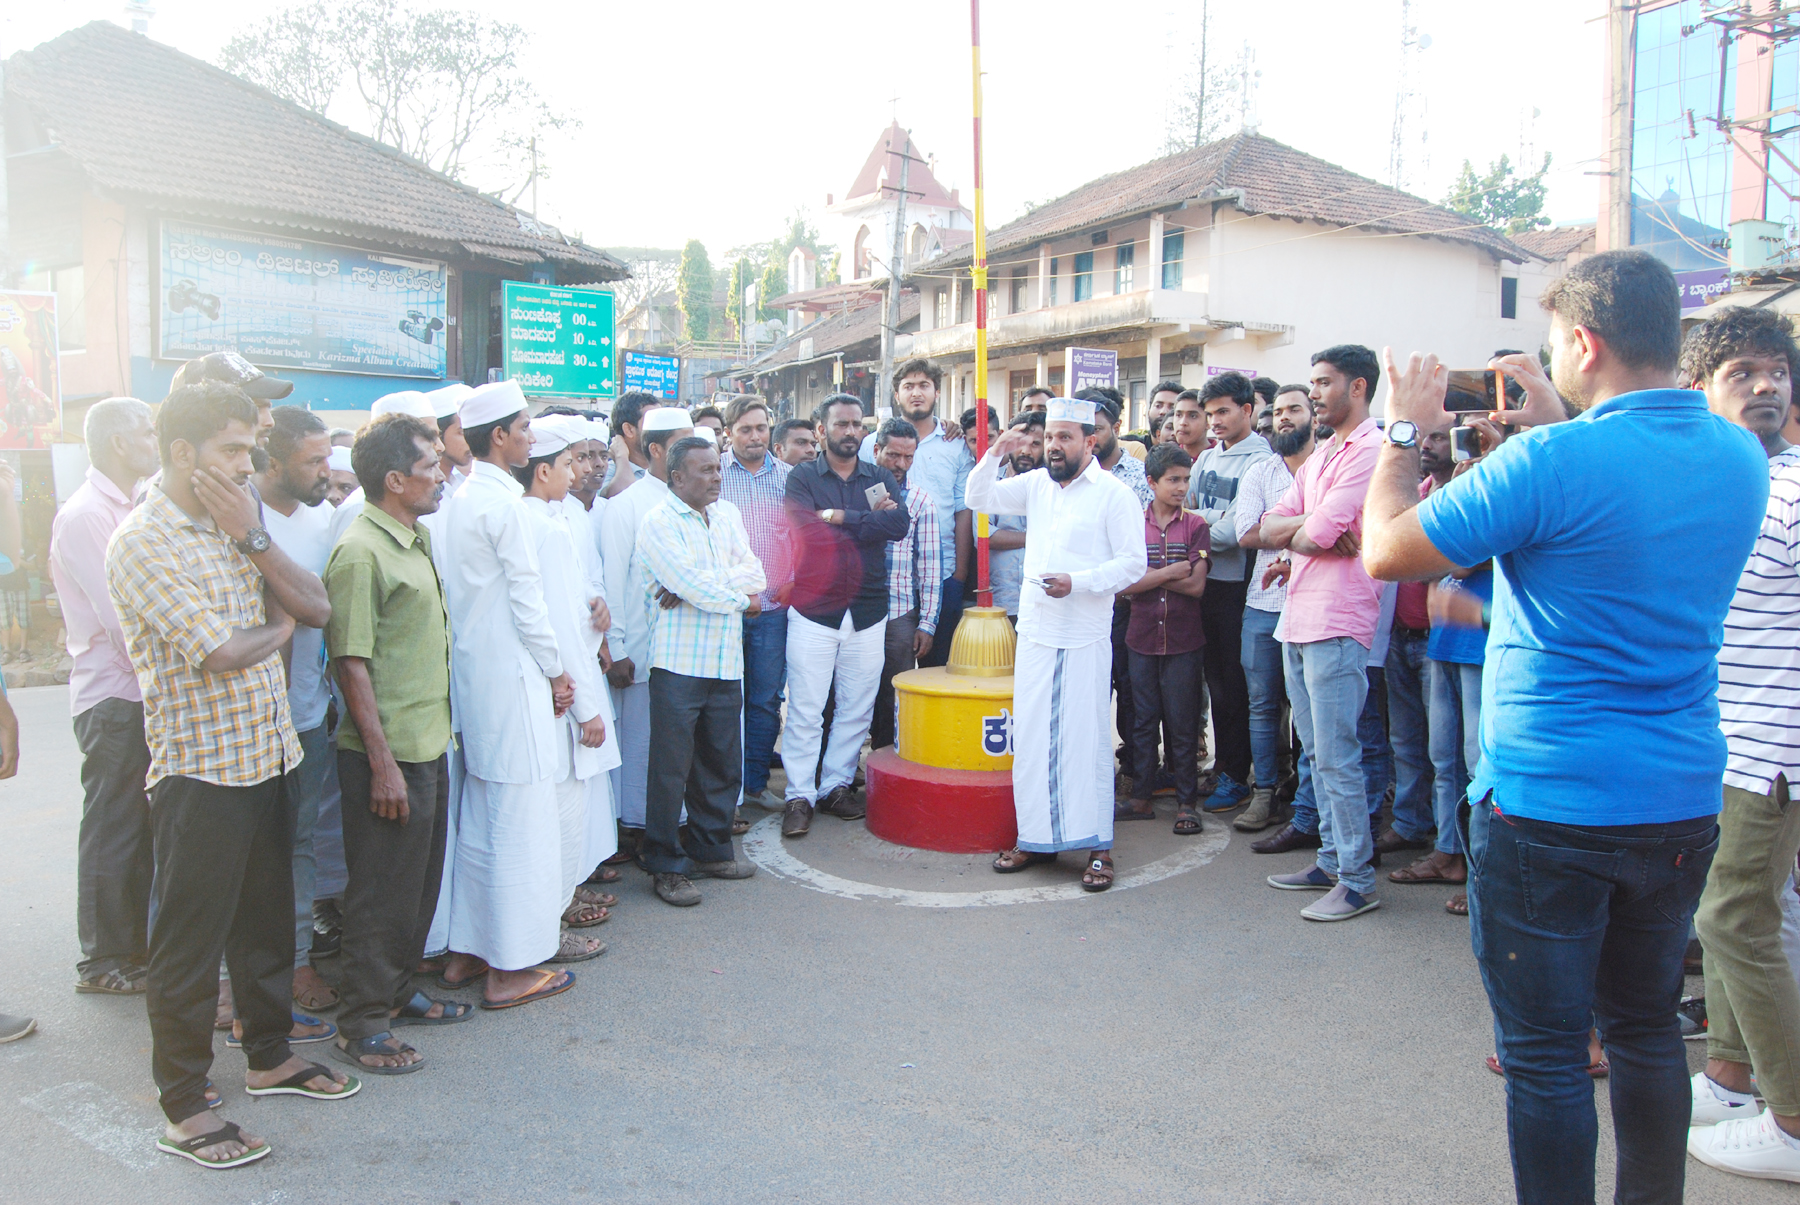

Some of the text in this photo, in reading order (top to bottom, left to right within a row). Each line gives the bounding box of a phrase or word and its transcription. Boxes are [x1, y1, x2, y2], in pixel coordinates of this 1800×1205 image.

[572, 312, 587, 326] 00
[573, 332, 585, 345] 10
[352, 343, 397, 356] Specialist
[318, 350, 438, 370] Karizma Album Creations
[573, 353, 587, 366] 30
[1075, 377, 1111, 392] ATM
